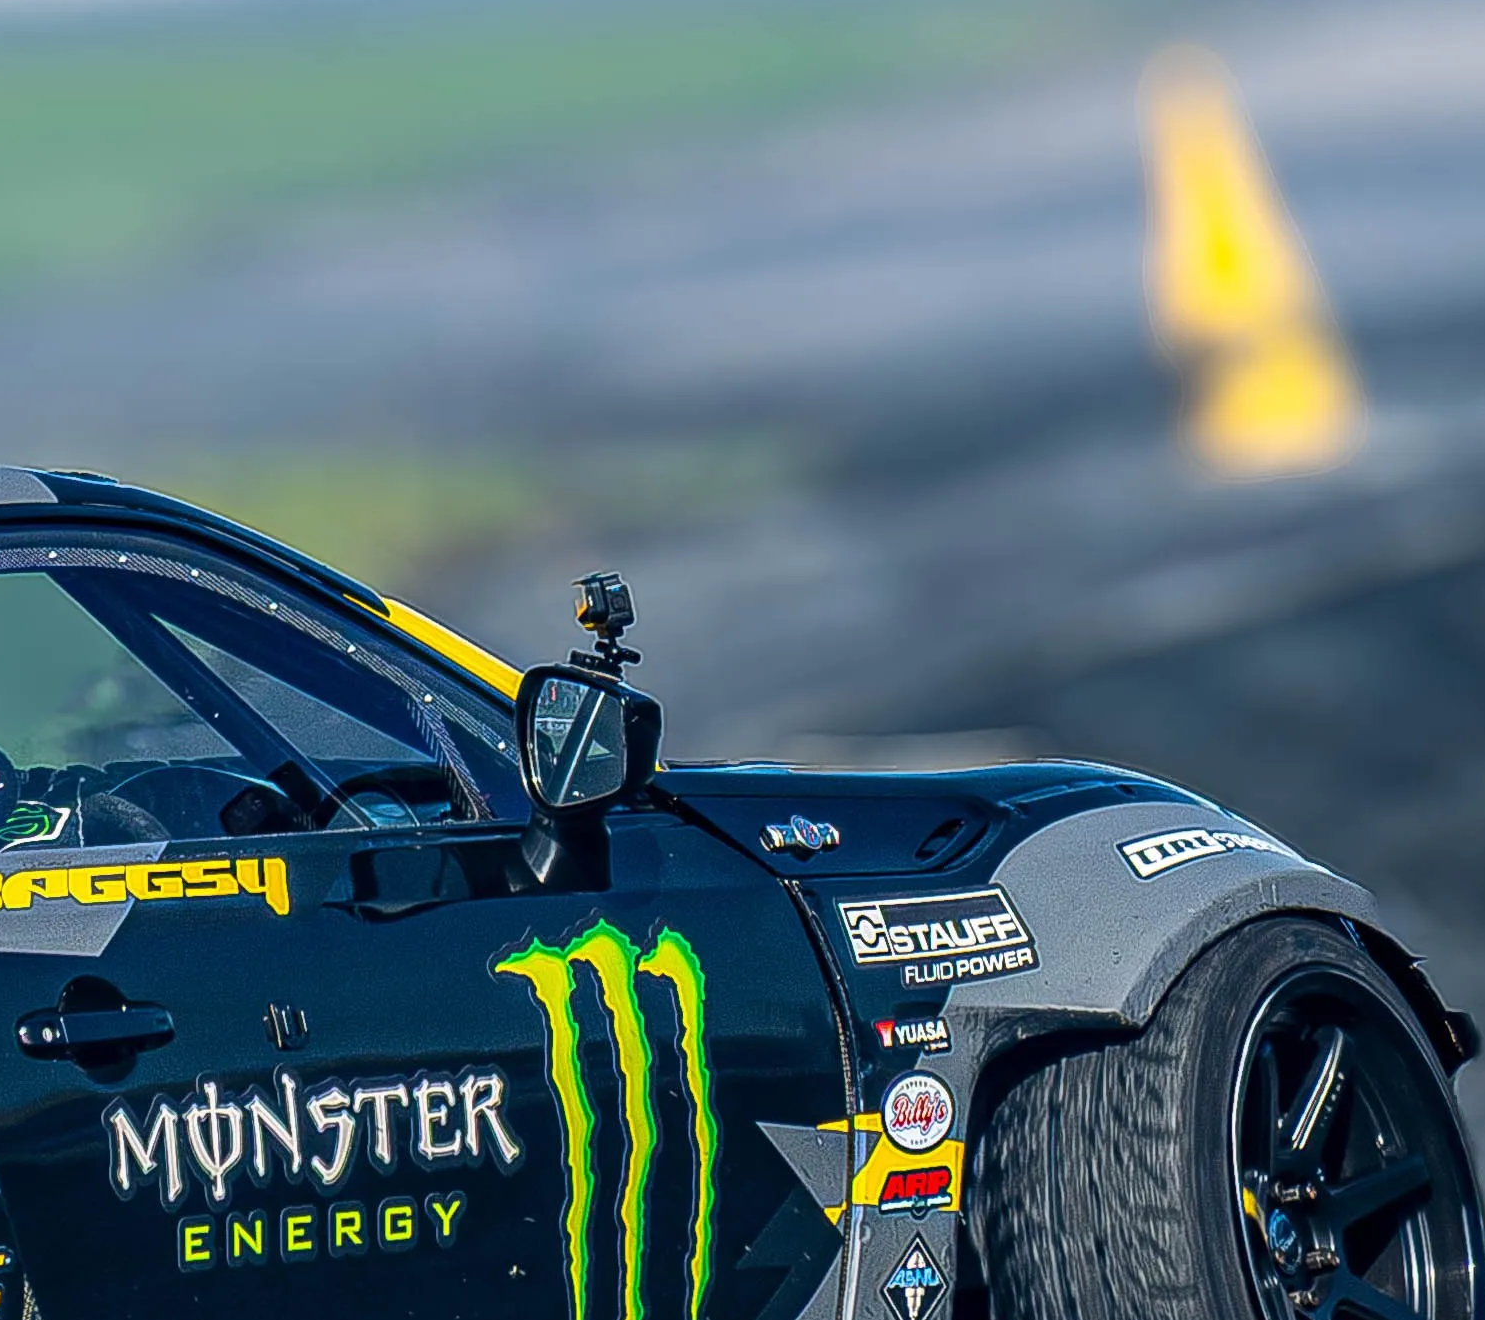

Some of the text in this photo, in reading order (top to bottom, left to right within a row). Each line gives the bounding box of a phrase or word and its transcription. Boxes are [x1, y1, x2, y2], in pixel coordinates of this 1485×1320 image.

[888, 913, 1017, 954] STAUFF
[905, 947, 1034, 984] FLUID POWER
[895, 1020, 948, 1045] YUASA
[892, 1092, 947, 1133] Billy's
[114, 1074, 520, 1203] MONSTER
[882, 1170, 951, 1200] ARP
[184, 1200, 463, 1264] ENERGY
